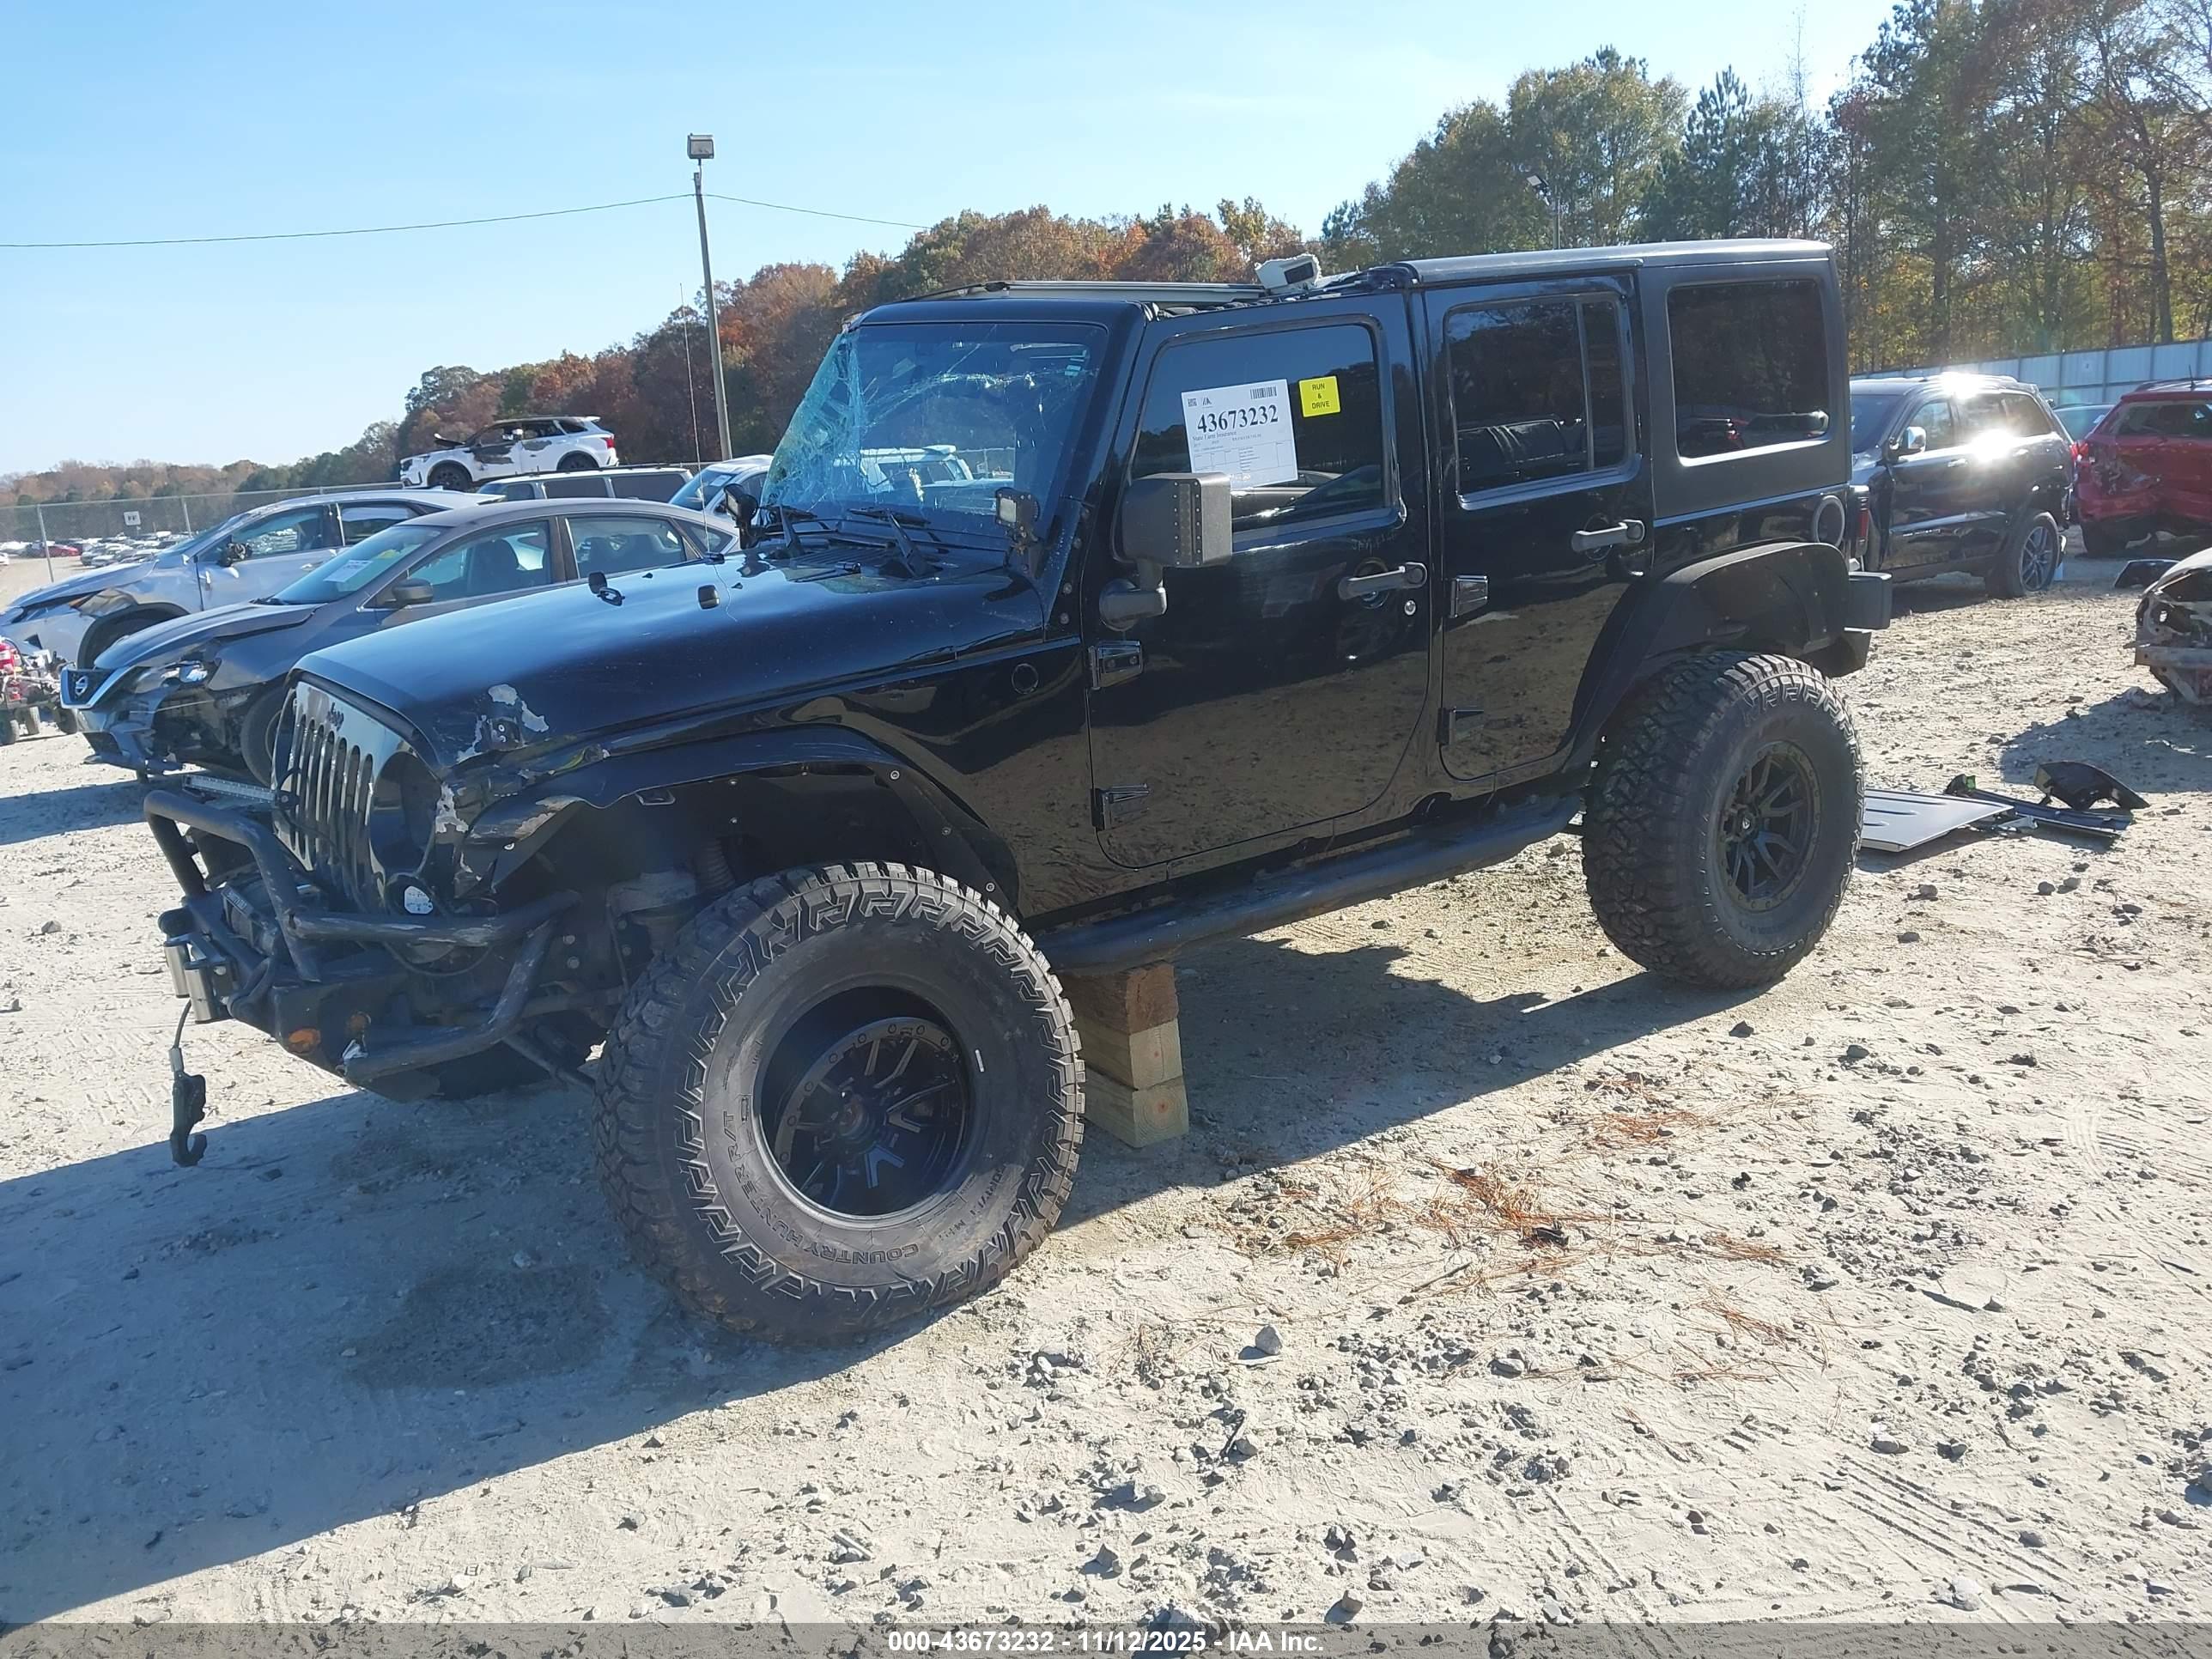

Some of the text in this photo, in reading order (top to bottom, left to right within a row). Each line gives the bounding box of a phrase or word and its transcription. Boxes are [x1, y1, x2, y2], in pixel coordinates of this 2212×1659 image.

[1197, 404, 1279, 433] 43673232
[734, 1164, 804, 1248] HUNTER
[804, 1243, 919, 1265] COUNTRY
